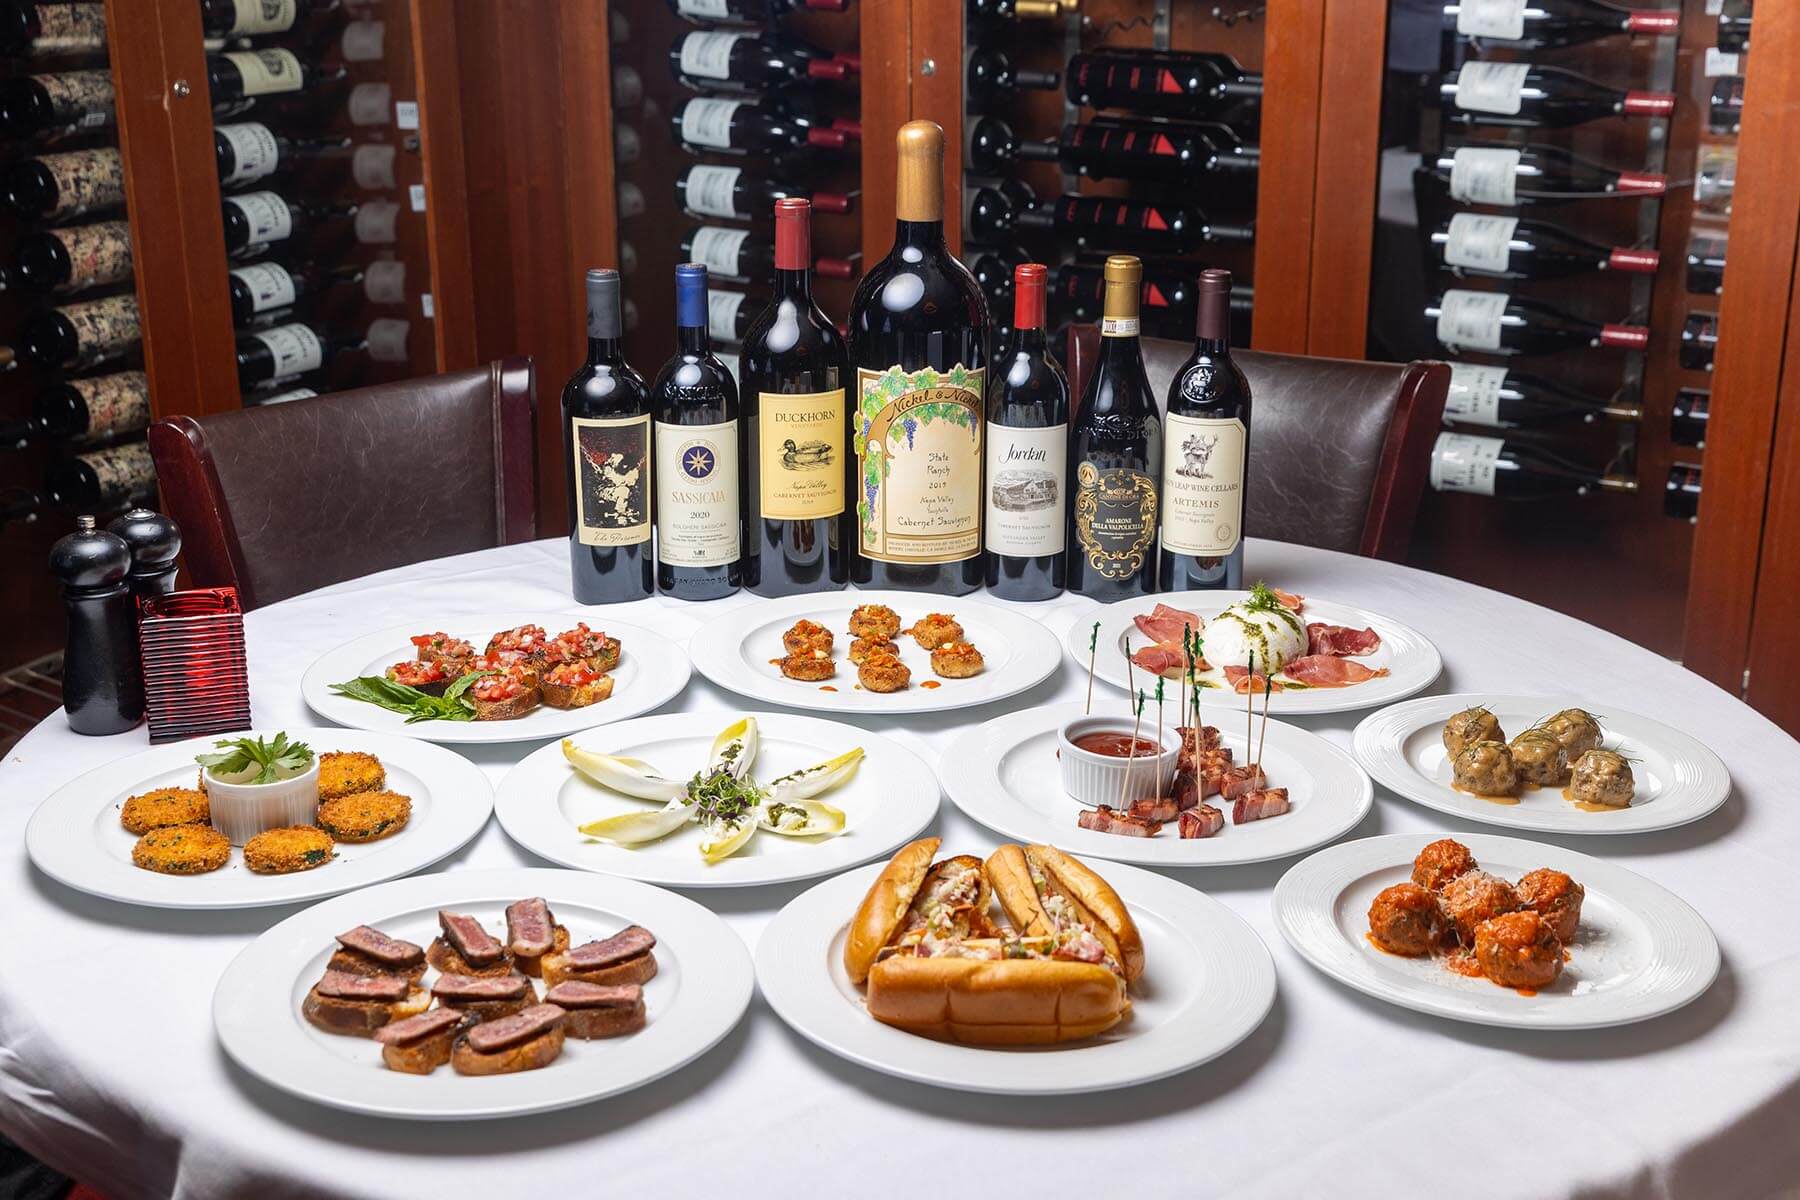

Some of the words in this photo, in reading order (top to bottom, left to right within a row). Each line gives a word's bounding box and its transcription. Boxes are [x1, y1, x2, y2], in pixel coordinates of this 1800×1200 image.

[886, 389, 933, 422] Nickel
[775, 409, 836, 423] DUCKHORN
[998, 443, 1046, 464] Jordan
[927, 465, 950, 477] Ranch
[1191, 484, 1210, 492] WINE
[1210, 482, 1239, 492] CELLARS
[672, 490, 726, 504] SASSICAIA
[1172, 497, 1219, 509] ARTEMIS
[689, 511, 711, 519] 2020
[897, 515, 934, 529] Cabernet
